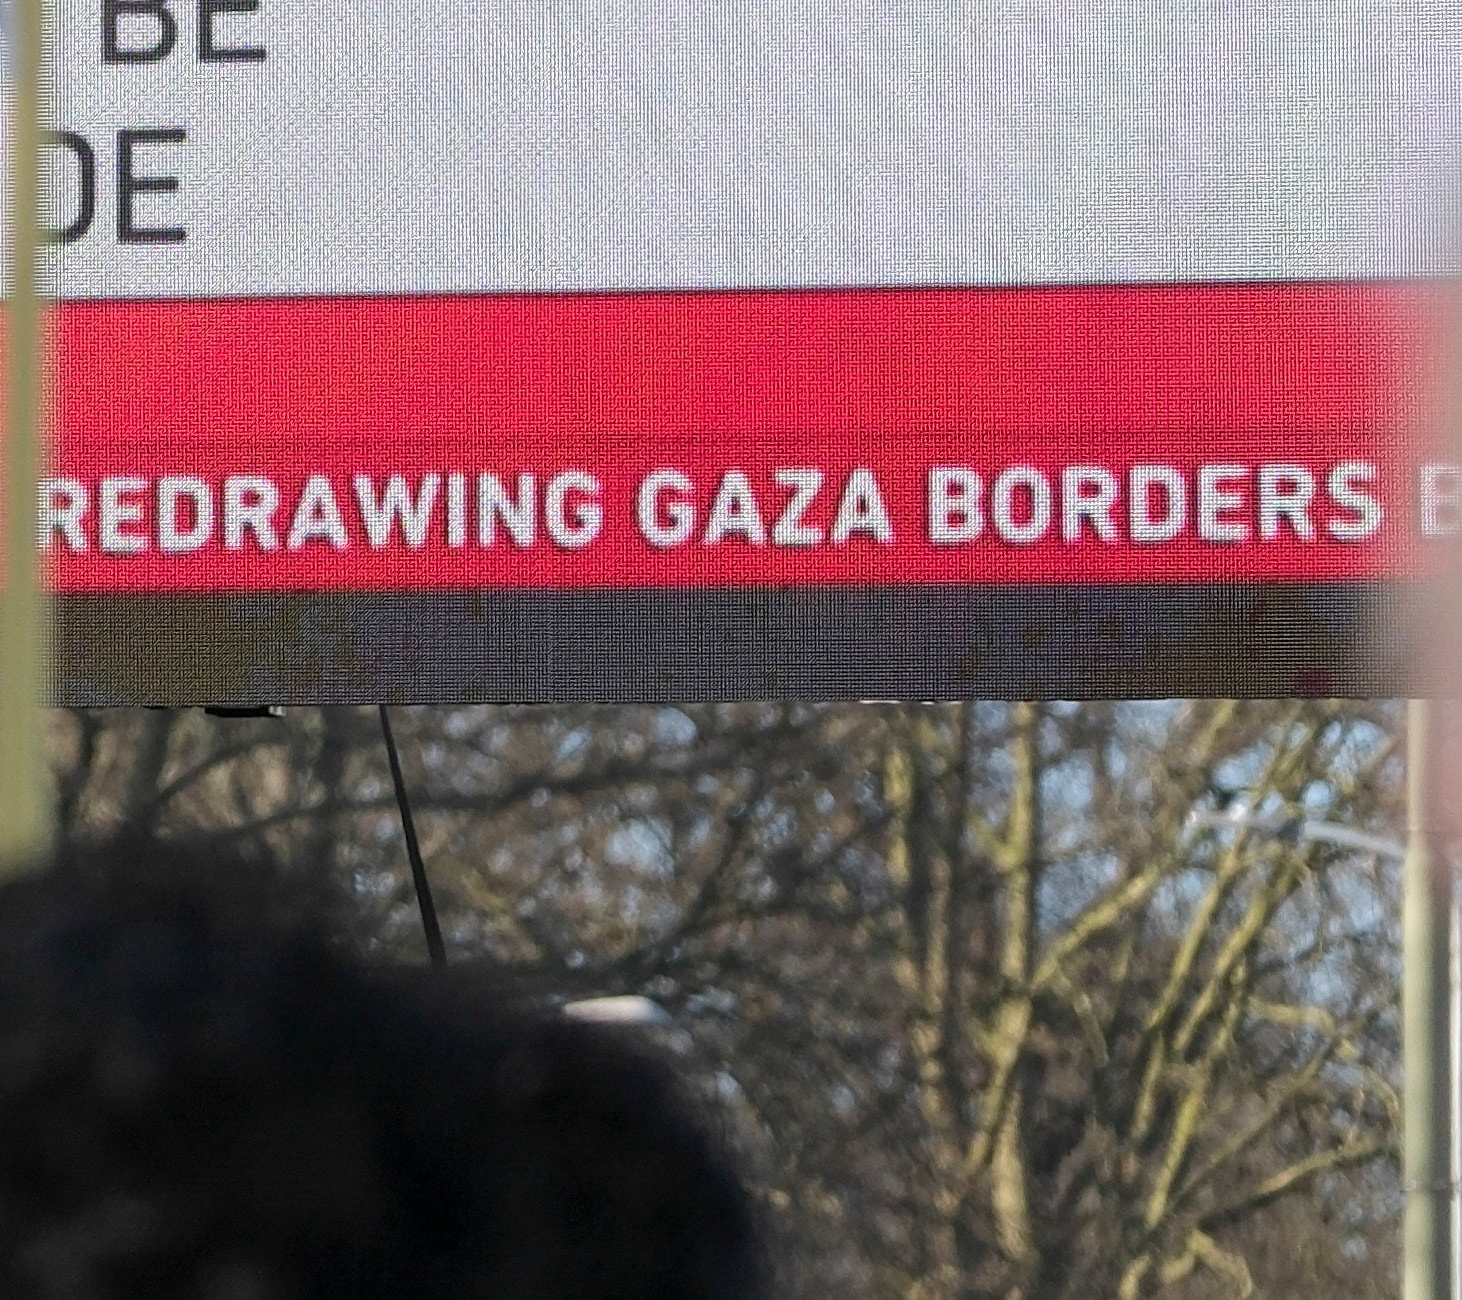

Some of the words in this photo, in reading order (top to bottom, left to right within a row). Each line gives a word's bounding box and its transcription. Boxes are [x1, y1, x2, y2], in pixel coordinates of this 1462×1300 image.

[36, 468, 604, 554] REDRAWING
[634, 467, 895, 549] GAZA
[927, 462, 1386, 545] BORDERS
